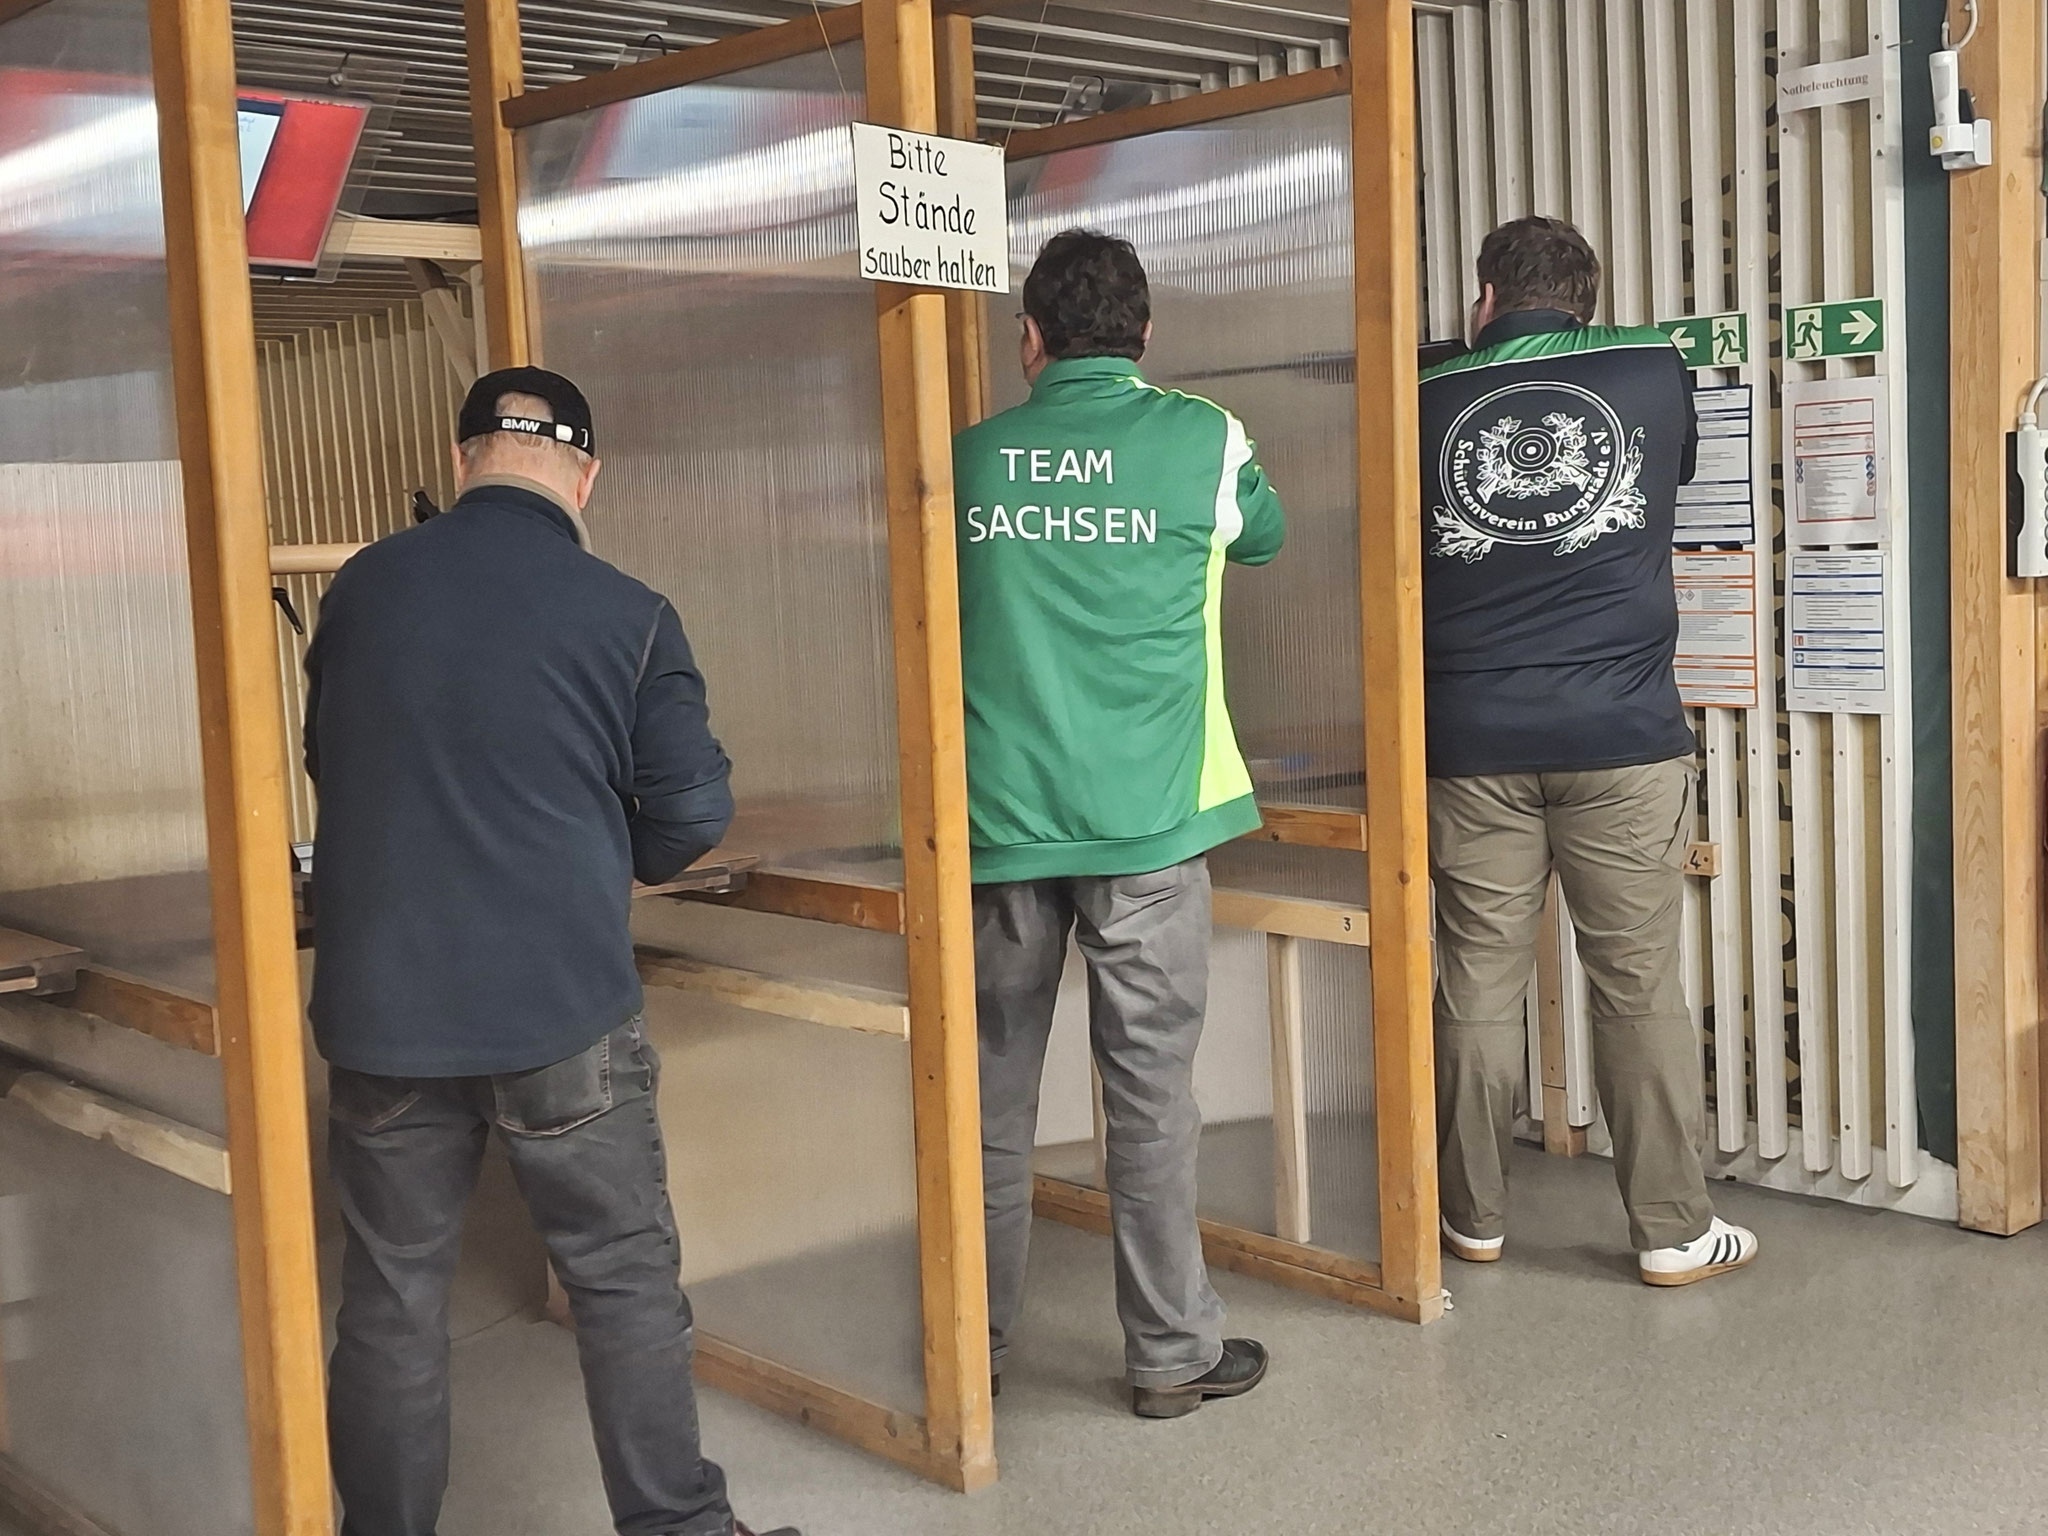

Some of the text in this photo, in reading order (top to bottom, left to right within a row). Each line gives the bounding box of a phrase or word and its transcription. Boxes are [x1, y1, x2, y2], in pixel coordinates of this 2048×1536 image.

[1782, 74, 1869, 96] Notbeleuchtung
[888, 133, 948, 176] Bitte
[879, 181, 976, 235] Stände
[865, 245, 997, 287] sauber halten
[501, 418, 541, 433] BMW
[999, 448, 1114, 484] TEAM
[967, 504, 1157, 543] SACHSEN
[1690, 849, 1701, 870] 4
[1343, 916, 1351, 932] 3
